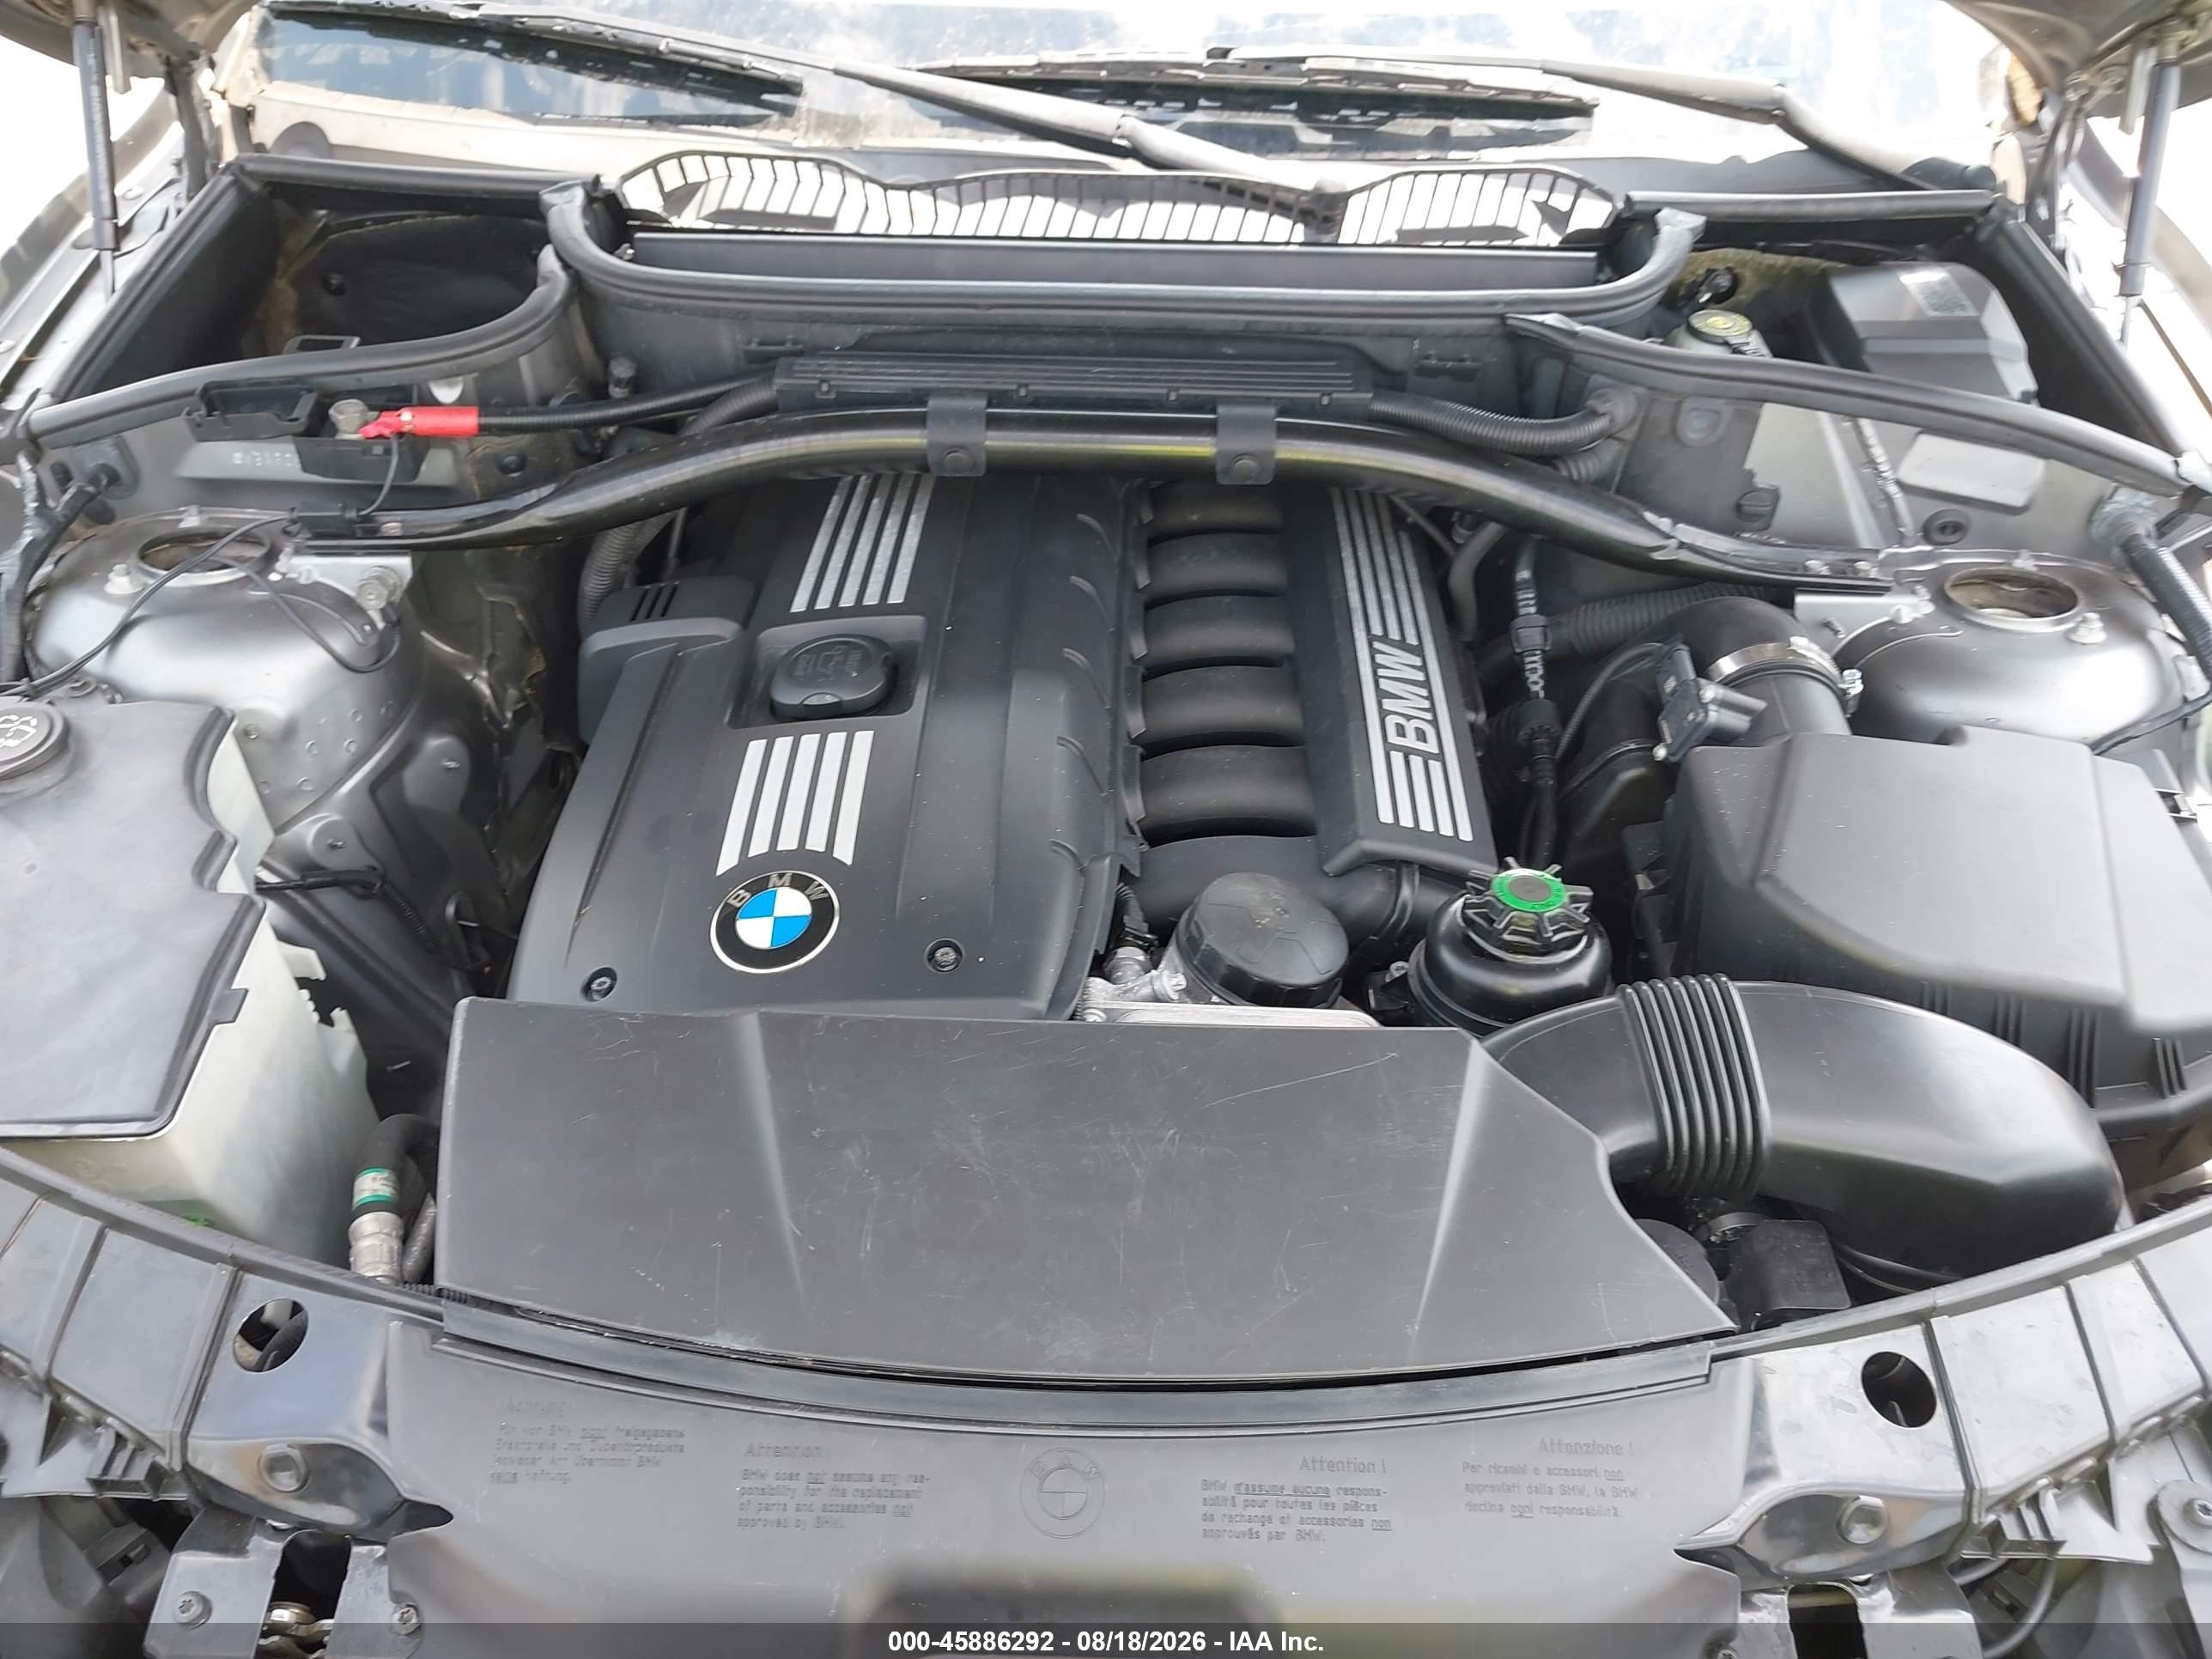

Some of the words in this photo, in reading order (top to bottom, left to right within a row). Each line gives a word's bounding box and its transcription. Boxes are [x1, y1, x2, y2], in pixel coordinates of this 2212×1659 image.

[1372, 641, 1439, 753] BMW
[726, 872, 829, 908] BMW
[1299, 1456, 1376, 1474] Attention
[1462, 1462, 1482, 1474] Per
[1201, 1480, 1227, 1492] BMW
[1291, 1485, 1331, 1498] aucune
[1337, 1486, 1387, 1499] respons-
[1612, 1486, 1638, 1498] BMW
[1243, 1498, 1268, 1510] pour
